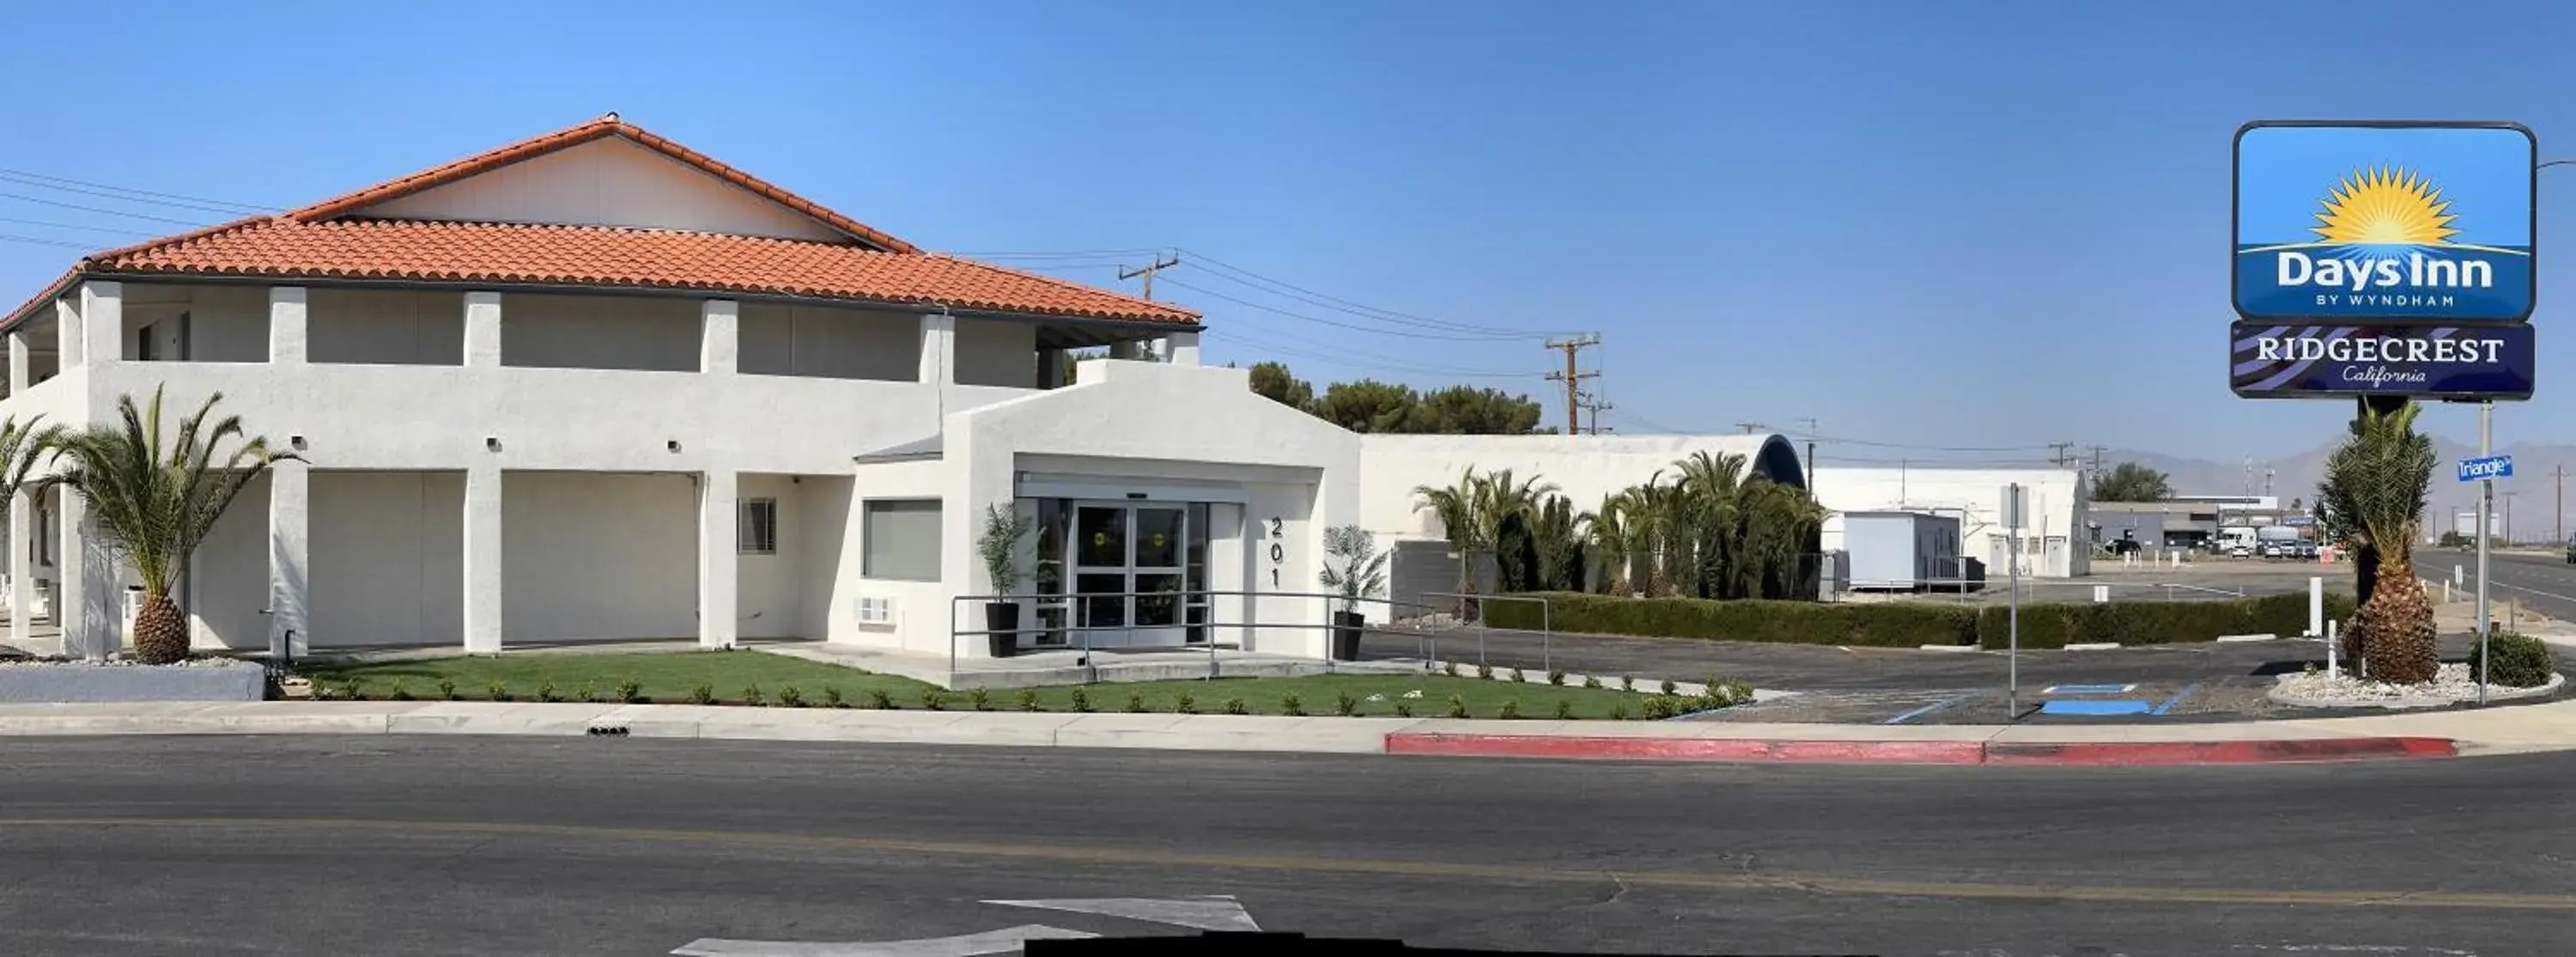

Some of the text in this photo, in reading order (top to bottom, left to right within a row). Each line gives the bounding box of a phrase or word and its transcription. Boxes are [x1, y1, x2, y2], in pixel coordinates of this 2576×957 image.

[2278, 251, 2493, 291] Days Inn
[2316, 295, 2454, 307] BY WYNDHAM
[2257, 337, 2505, 363] RIDGECREST
[2342, 365, 2427, 388] California
[2459, 458, 2505, 478] Triangle
[1271, 516, 1283, 589] 201
